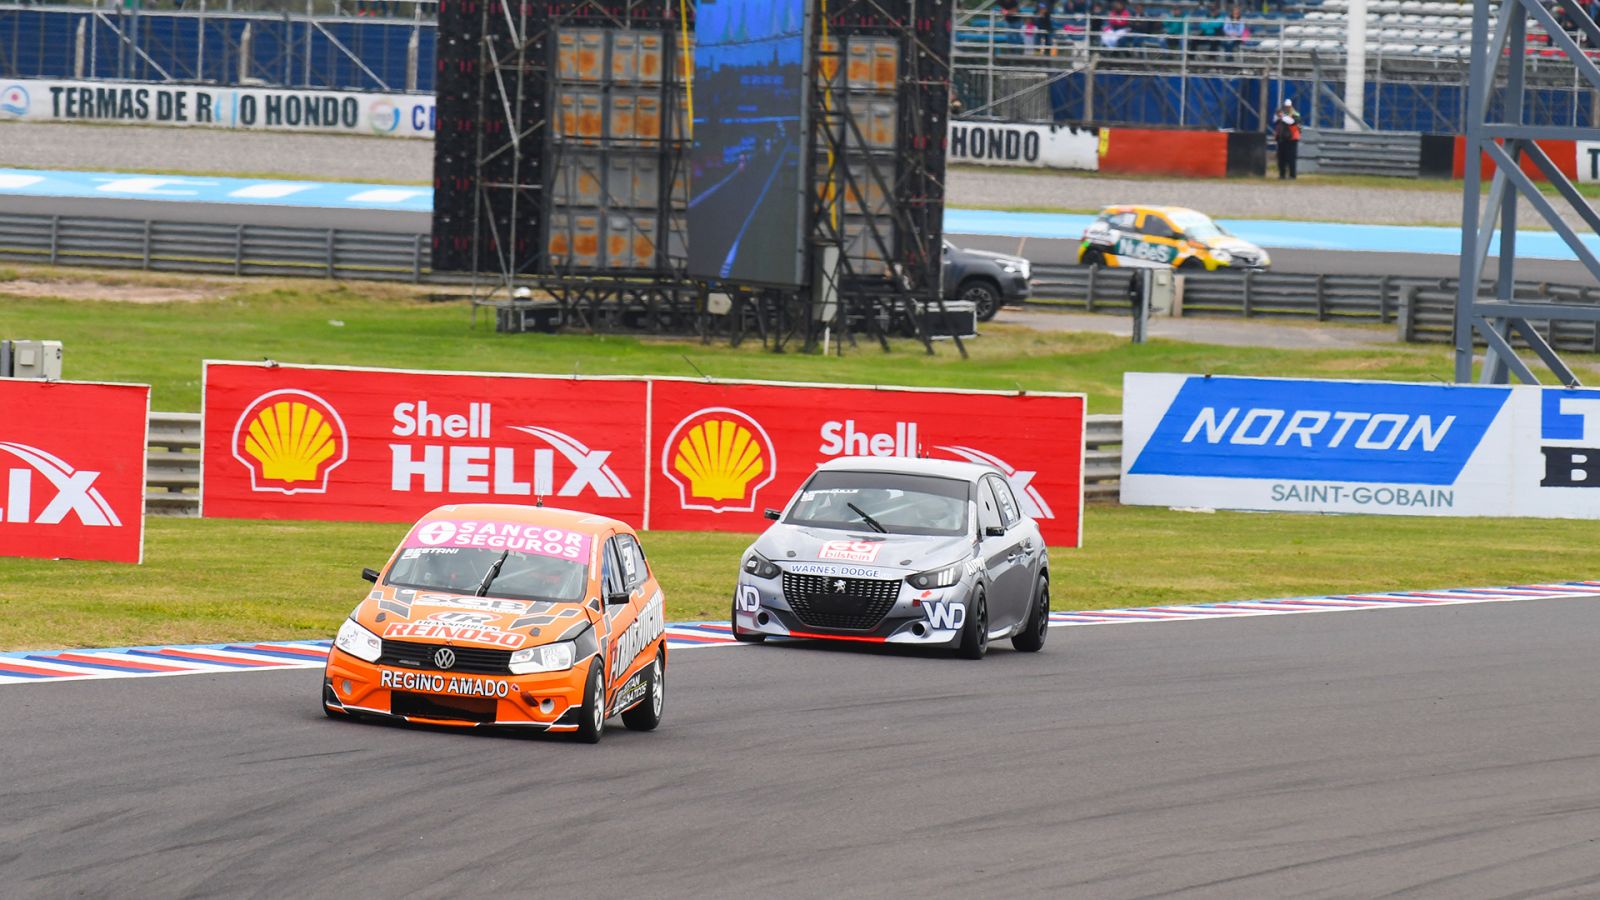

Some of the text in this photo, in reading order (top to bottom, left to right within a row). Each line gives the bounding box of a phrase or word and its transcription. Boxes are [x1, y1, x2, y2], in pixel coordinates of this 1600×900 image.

[49, 86, 149, 119] TERMAS
[156, 90, 187, 122] DE
[265, 94, 358, 128] HONDO
[951, 126, 1040, 162] HONDO
[392, 401, 491, 438] Shell
[1182, 407, 1457, 452] NORTON
[819, 420, 917, 458] Shell
[388, 426, 631, 498] HELIX
[1271, 484, 1454, 508] SAINT-GOBAIN
[454, 534, 581, 558] SEGUROS
[458, 521, 583, 548] SANCOR
[792, 565, 836, 574] WARNES
[824, 551, 871, 561] bilstein
[841, 567, 880, 578] DODGE
[921, 600, 966, 630] WD
[384, 624, 525, 648] REINOSO
[447, 676, 510, 698] AMADO
